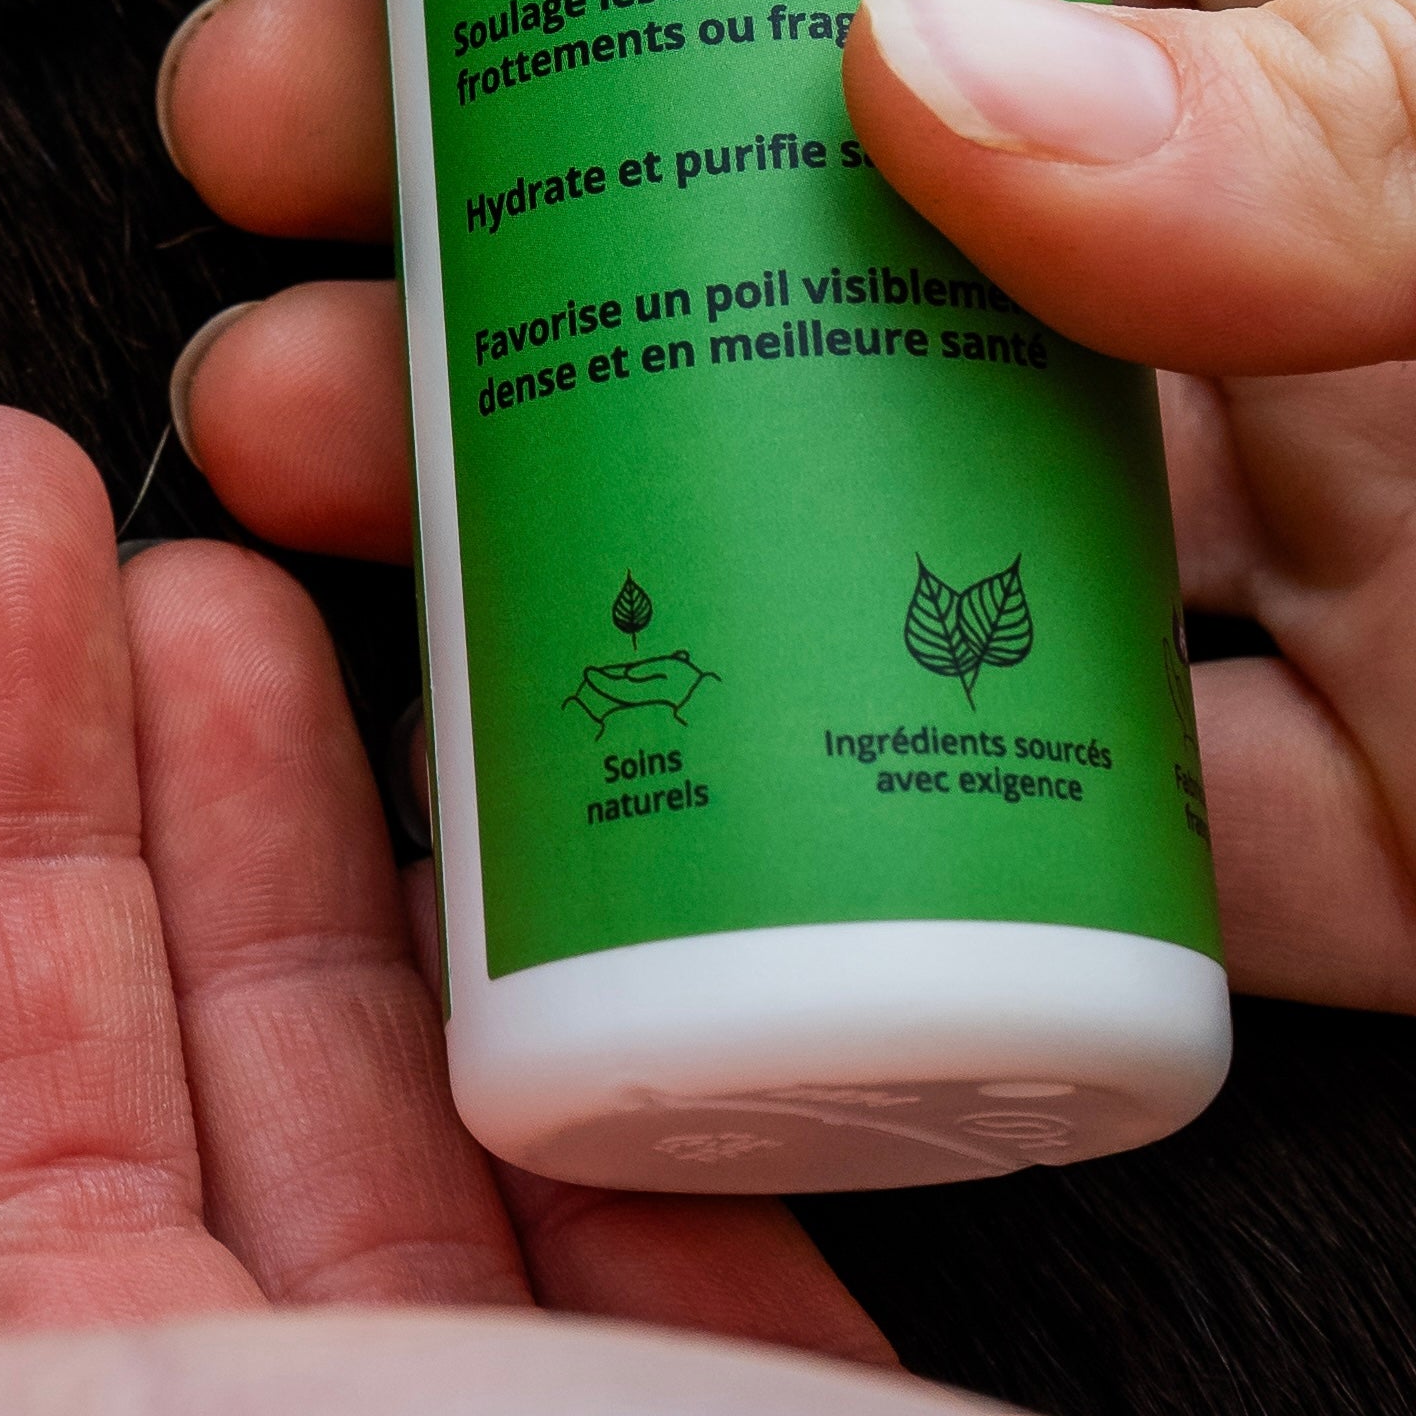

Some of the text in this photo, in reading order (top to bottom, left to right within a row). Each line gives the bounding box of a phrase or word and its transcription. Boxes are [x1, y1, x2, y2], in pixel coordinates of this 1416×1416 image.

[456, 22, 686, 106] frottements
[698, 17, 755, 46] ou
[466, 167, 606, 234] Hydrate
[618, 152, 664, 188] et
[675, 133, 827, 190] purifie
[476, 300, 622, 366] Favorise
[635, 289, 691, 322] un
[705, 270, 789, 322] poil
[478, 320, 1049, 417] dense et en meilleure santé
[603, 749, 683, 783] Soins
[825, 726, 1113, 770] Ingrédients sourcés
[587, 779, 709, 825] naturels
[877, 766, 1083, 804] avec exigence
